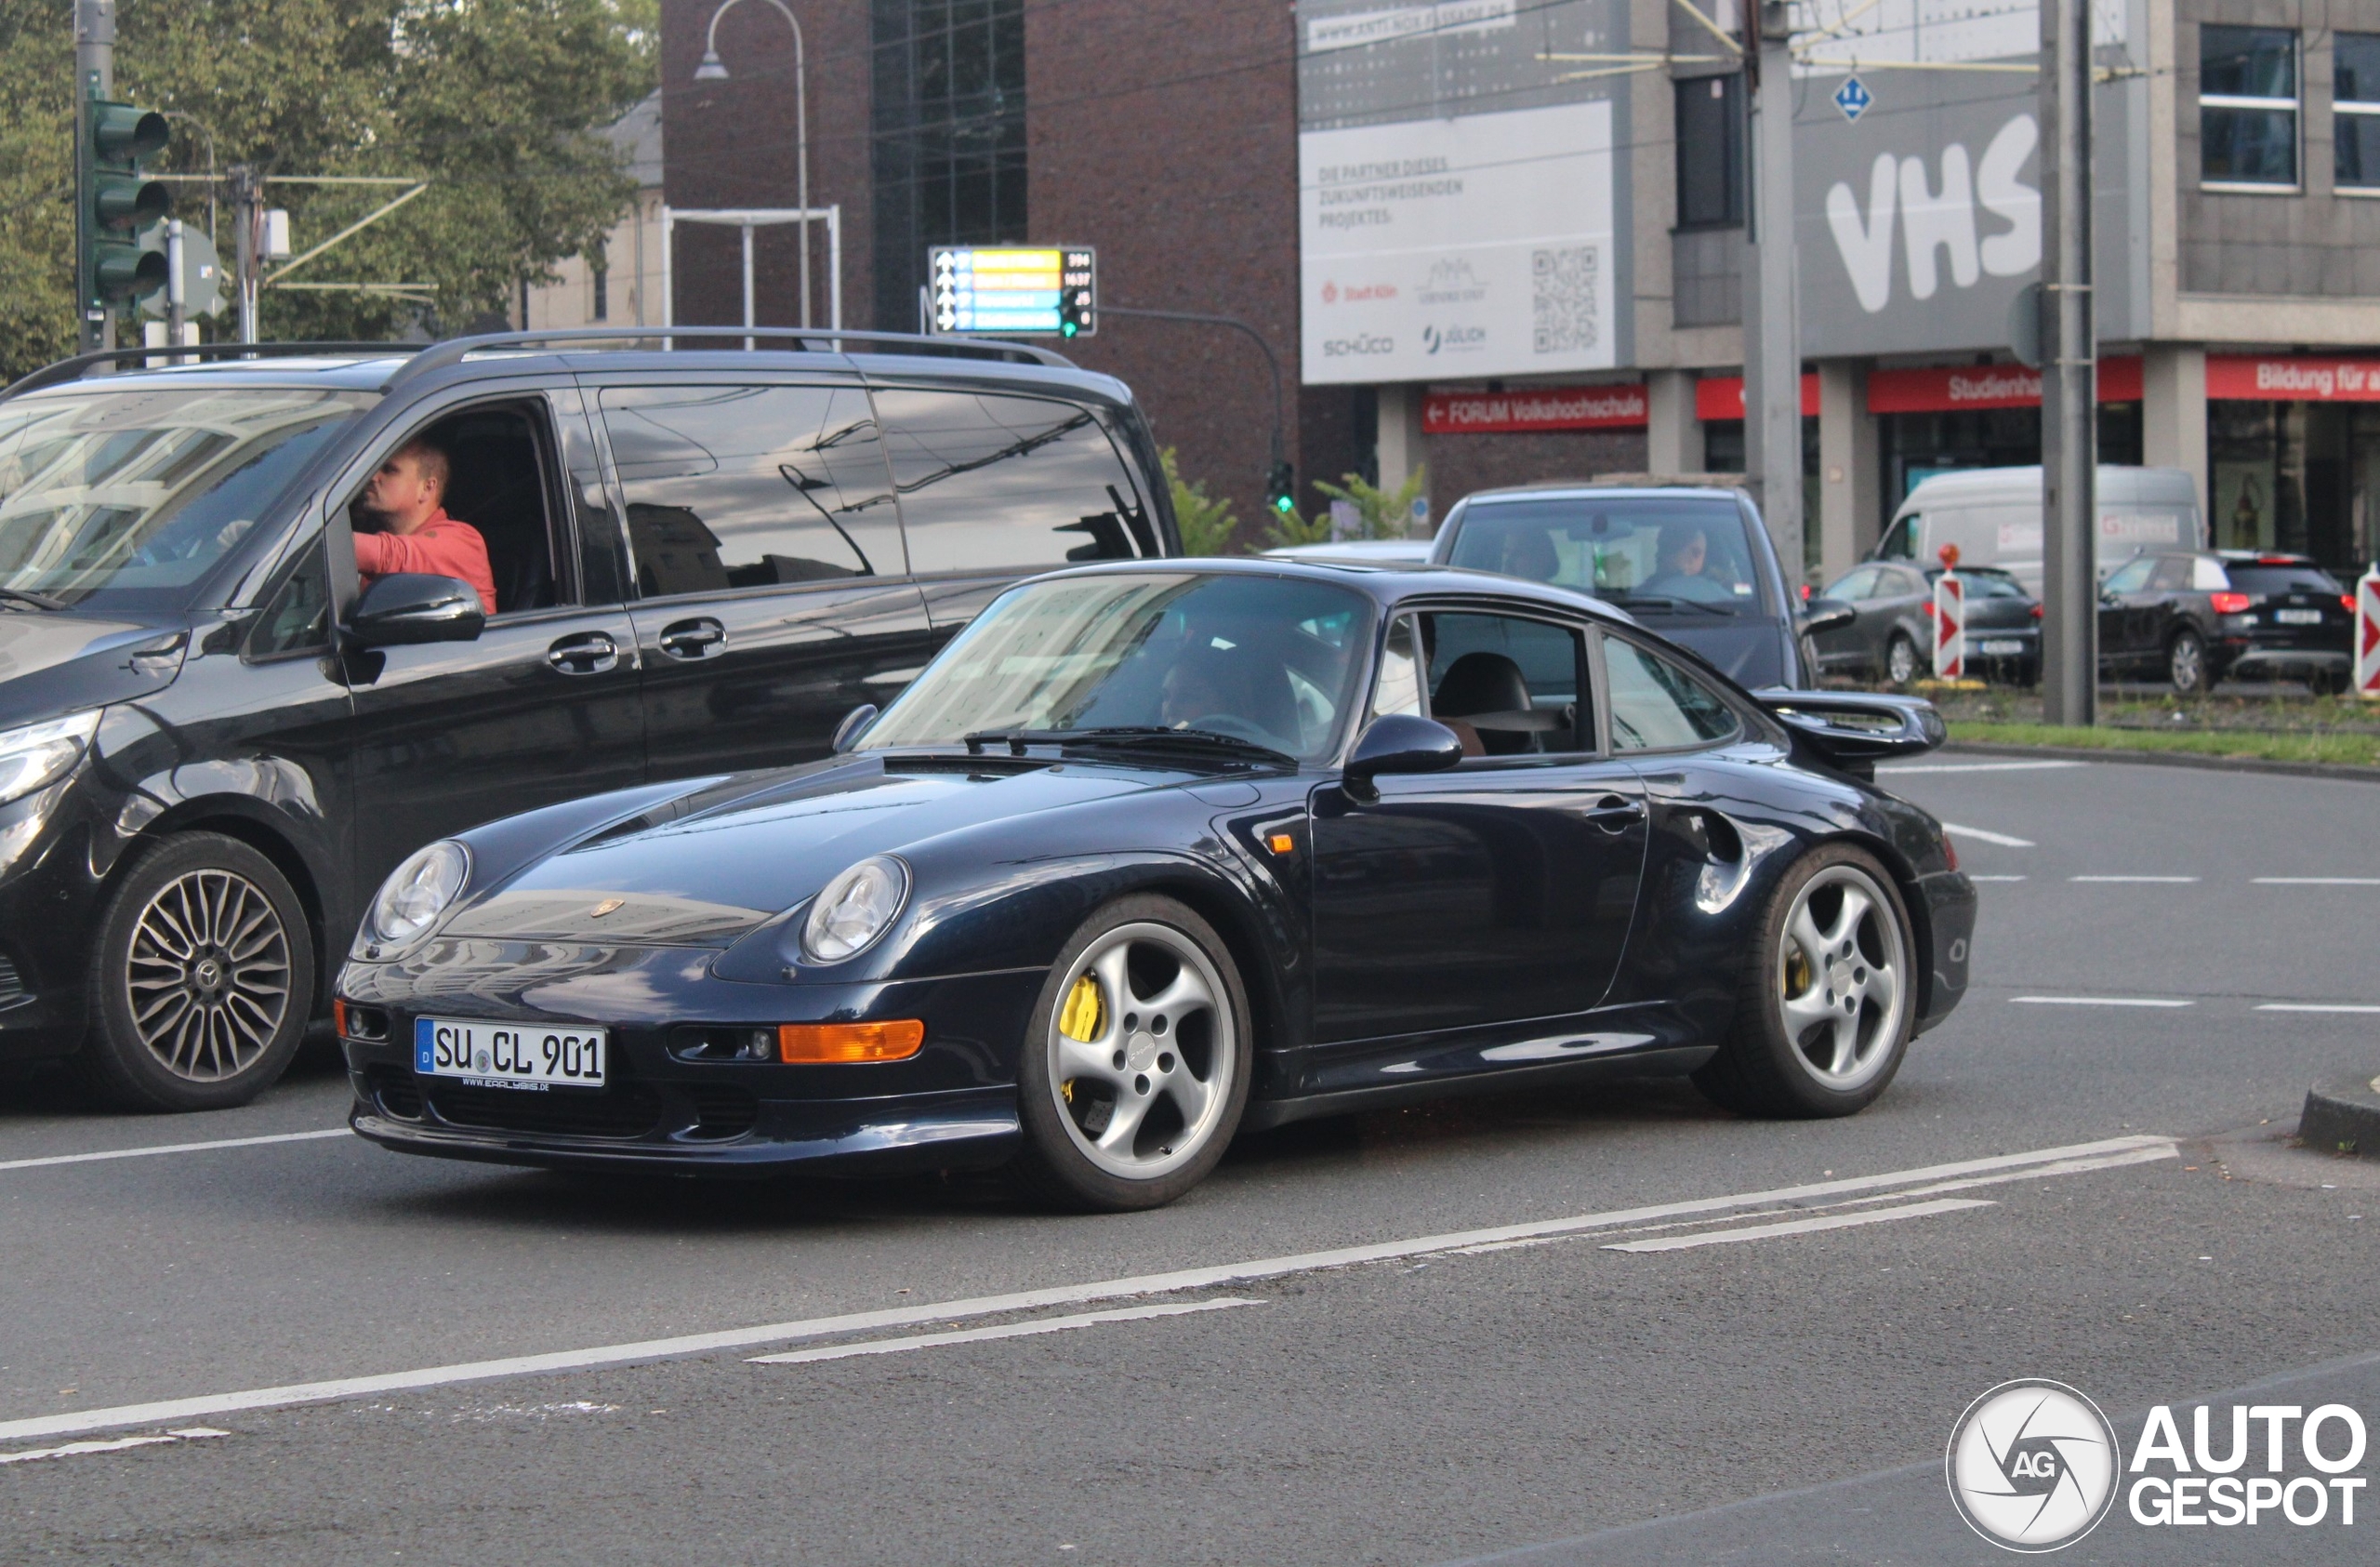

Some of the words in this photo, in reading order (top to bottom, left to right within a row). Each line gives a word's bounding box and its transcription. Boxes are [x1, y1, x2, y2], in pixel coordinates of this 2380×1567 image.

[1342, 160, 1400, 179] PARTNER
[1826, 113, 2041, 313] VHS
[2257, 363, 2334, 397] Bildung
[2336, 365, 2364, 392] für
[1448, 400, 1510, 424] FORUM
[1512, 393, 1644, 423] Volkshochschule
[435, 1027, 472, 1069] SU
[493, 1031, 533, 1074] CL
[542, 1034, 602, 1079] 901
